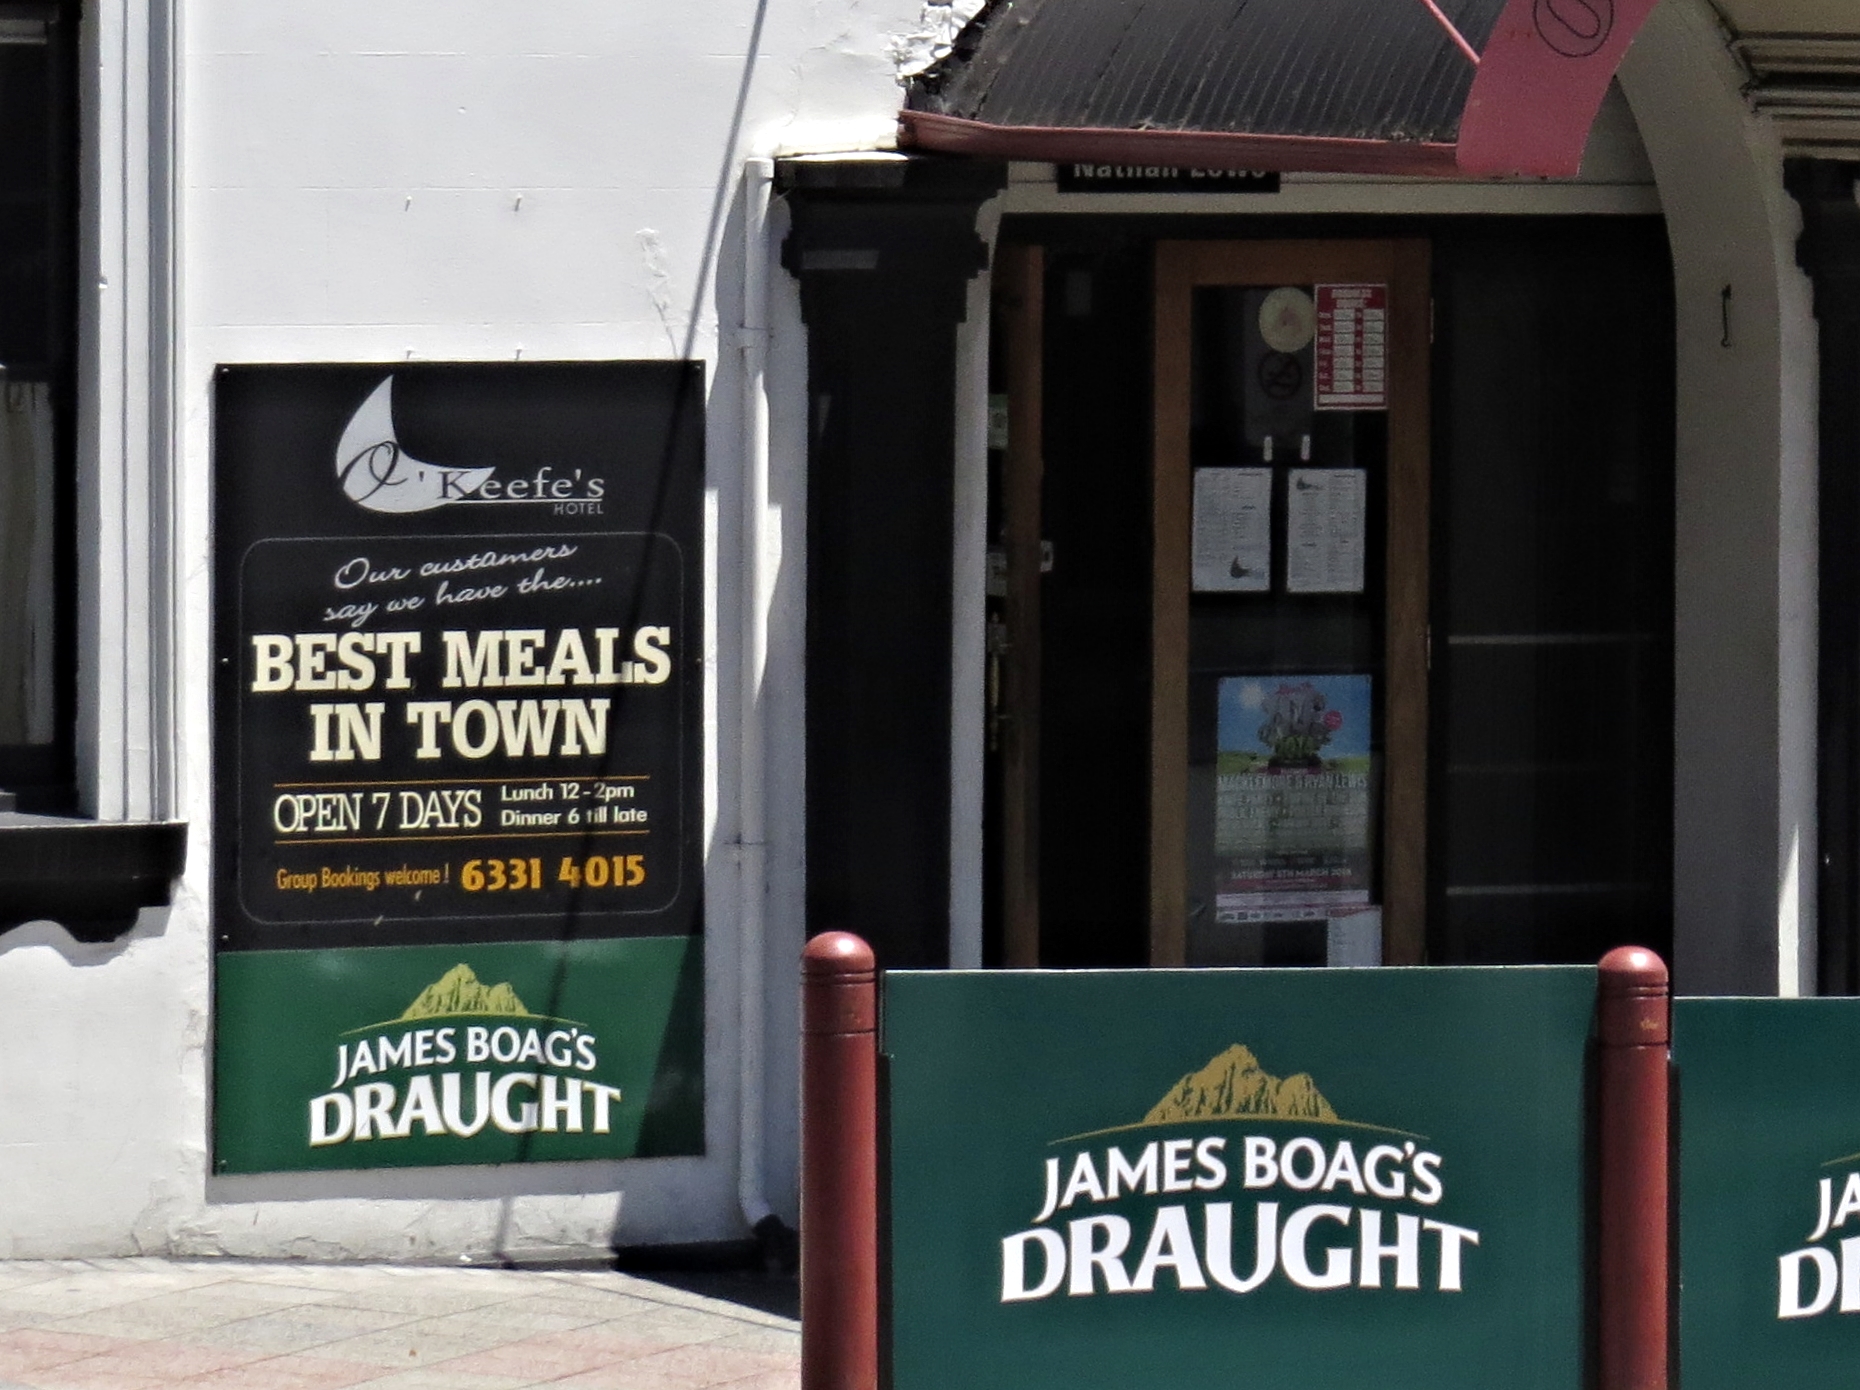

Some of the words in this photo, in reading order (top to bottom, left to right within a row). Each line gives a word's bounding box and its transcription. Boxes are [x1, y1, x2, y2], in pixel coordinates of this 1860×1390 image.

[554, 502, 604, 515] HOTEL
[334, 556, 409, 589] Our
[419, 543, 578, 578] customers
[322, 598, 378, 627] say
[386, 592, 425, 612] we
[435, 581, 508, 605] have
[251, 630, 422, 692] BEST
[440, 625, 672, 690] MEALS
[309, 701, 386, 763] IN
[406, 697, 612, 760] TOWN
[273, 791, 364, 833] OPEN
[371, 792, 390, 831] 7
[398, 788, 483, 830] DAYS
[501, 782, 554, 802] Lunch
[559, 783, 579, 800] 12
[593, 783, 635, 804] 2pm
[501, 808, 562, 827] Dinner
[567, 807, 580, 825] 6
[585, 806, 608, 825] till
[613, 806, 649, 824] late
[276, 869, 318, 893] Group
[321, 866, 381, 891] Bookings
[460, 856, 542, 892] 6331
[558, 854, 646, 888] 4015
[332, 1027, 456, 1089] JAMES
[466, 1026, 597, 1071] BOAG'S
[308, 1070, 621, 1148] DRAUGHT
[1031, 1137, 1228, 1224] JAMES
[1243, 1136, 1443, 1205] BOAG'S
[1000, 1200, 1480, 1303] DRAUGHT
